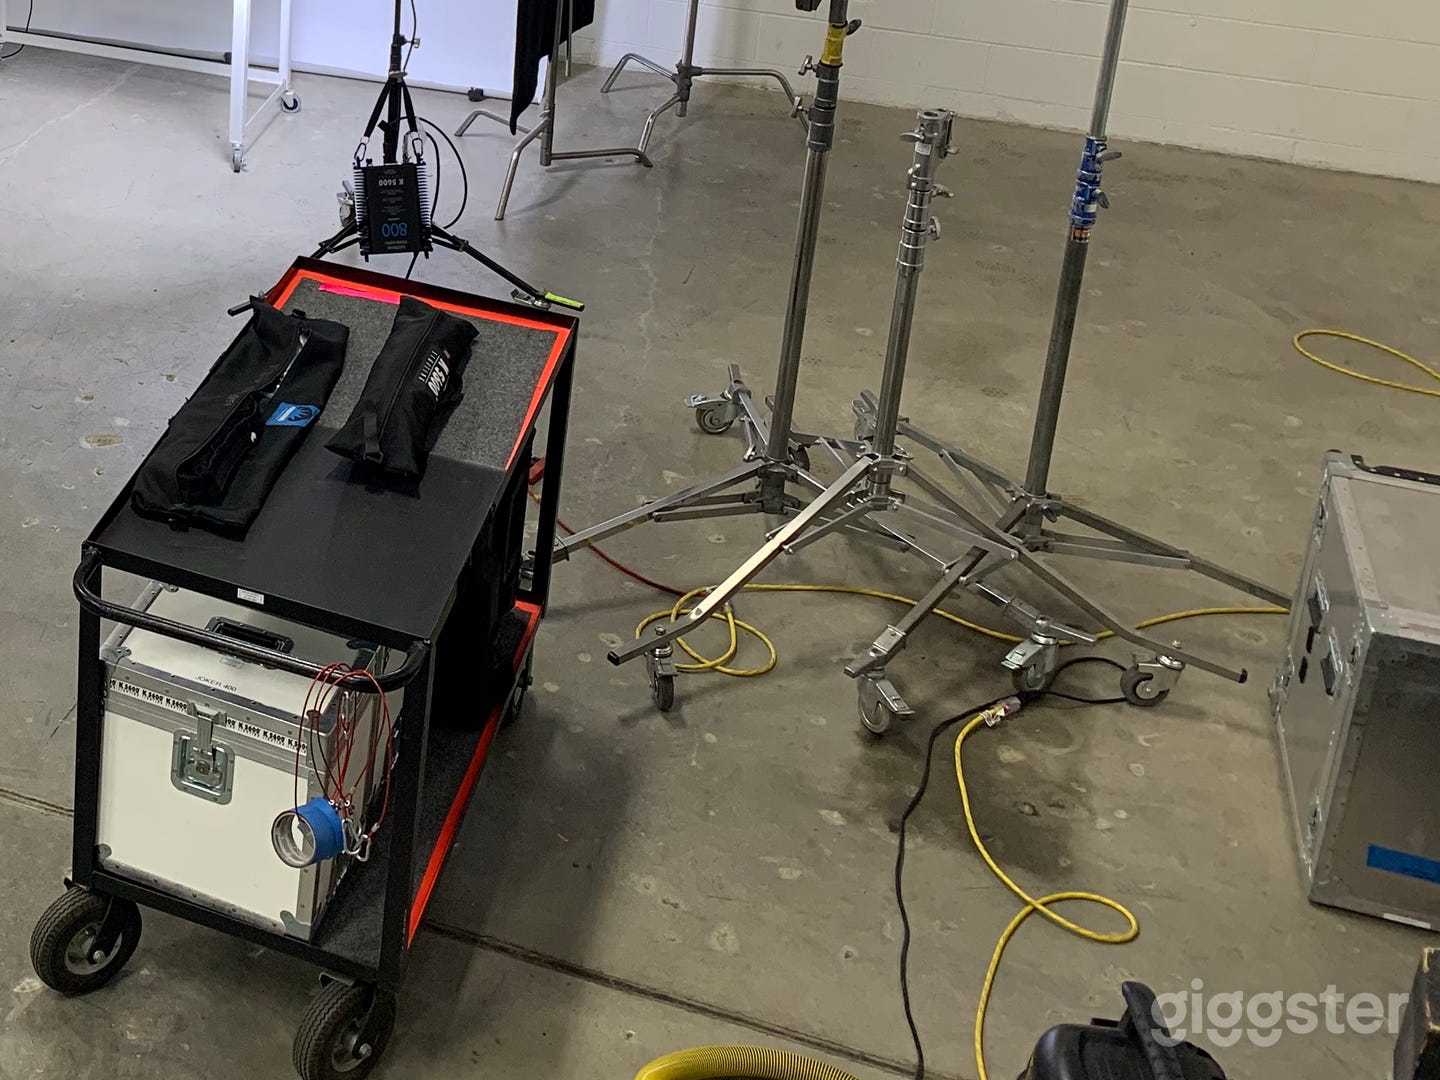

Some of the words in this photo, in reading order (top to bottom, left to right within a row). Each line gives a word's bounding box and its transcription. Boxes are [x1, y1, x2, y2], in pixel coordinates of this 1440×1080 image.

[378, 178, 397, 186] 5600
[381, 221, 408, 238] 800
[427, 366, 446, 397] 5600
[223, 683, 238, 691] 400
